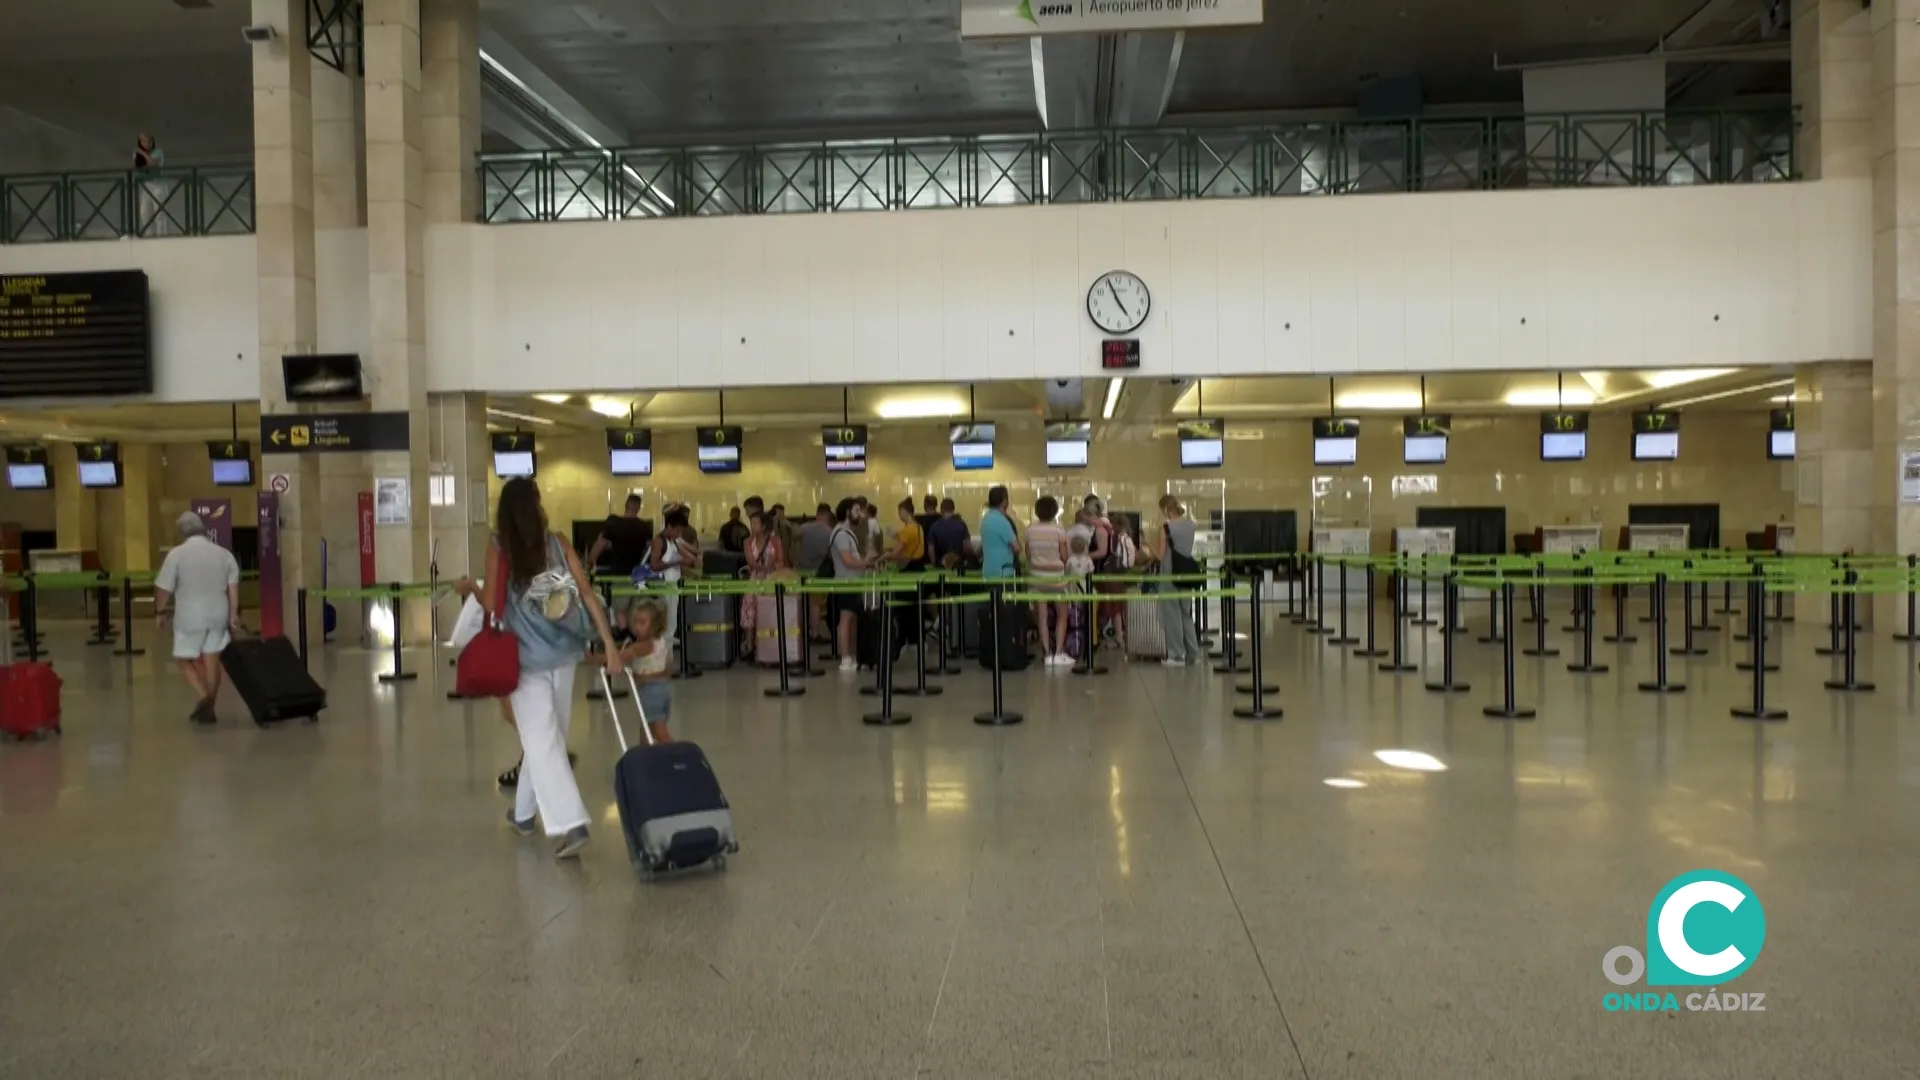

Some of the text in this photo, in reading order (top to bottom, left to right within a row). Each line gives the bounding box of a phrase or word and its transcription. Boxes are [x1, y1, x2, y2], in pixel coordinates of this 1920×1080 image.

[1039, 4, 1073, 16] aena
[1089, 0, 1163, 17] Aeropuerto
[1167, 0, 1183, 11] de
[1326, 420, 1345, 435] 14
[1554, 415, 1574, 431] 16
[1646, 414, 1666, 430] 17
[314, 435, 351, 447] Llegadas
[508, 436, 517, 449] 7
[714, 430, 725, 446] 9
[836, 429, 855, 445] 10
[94, 447, 102, 460] 3
[225, 445, 234, 457] 4
